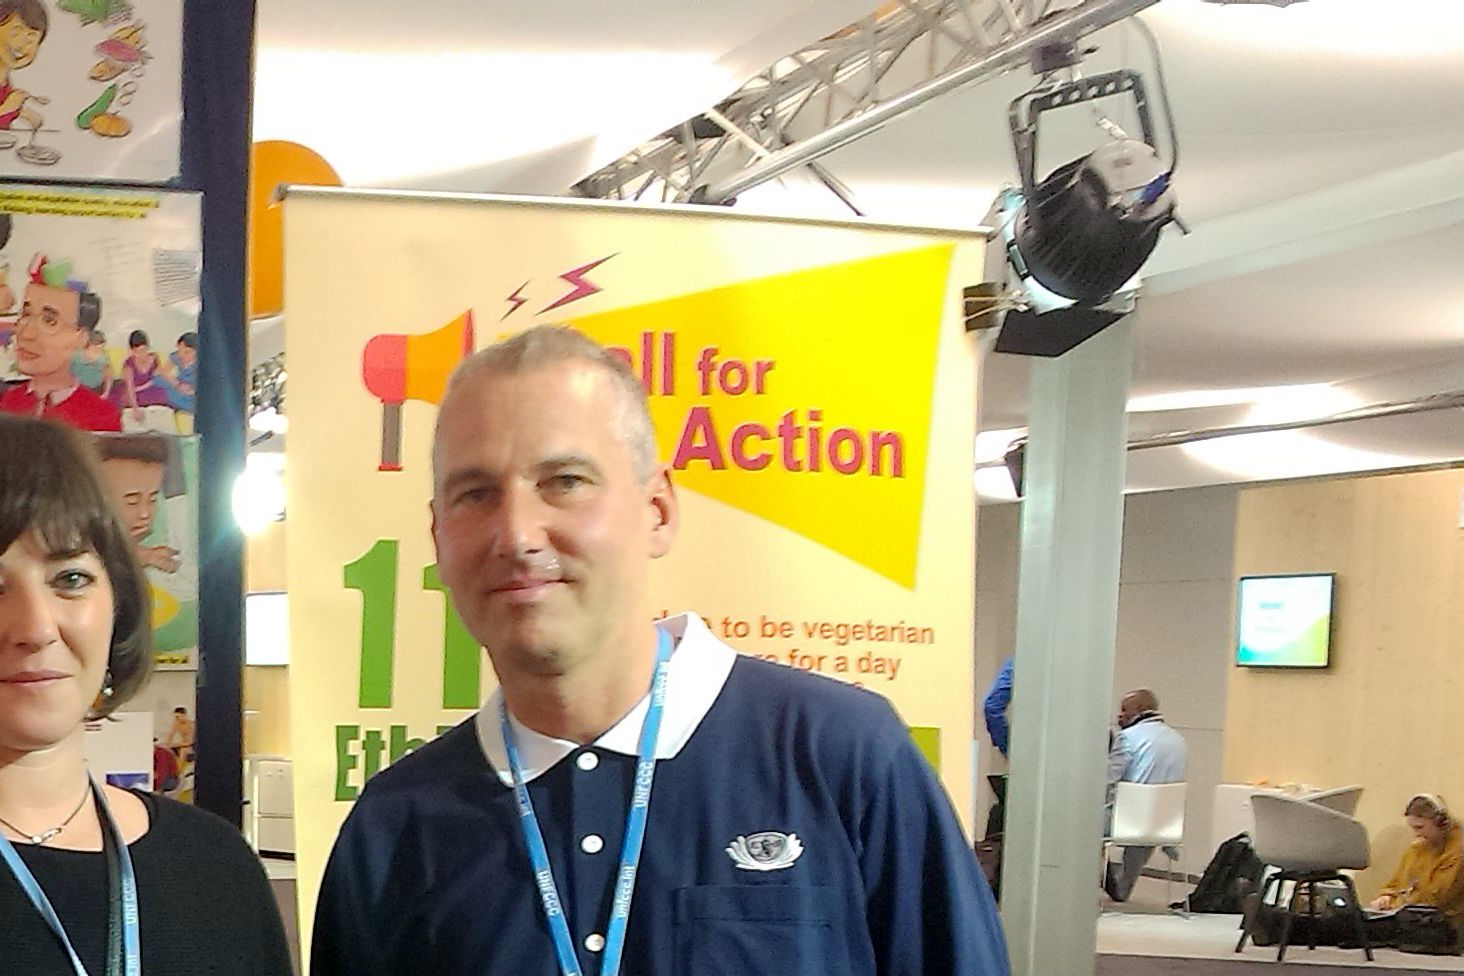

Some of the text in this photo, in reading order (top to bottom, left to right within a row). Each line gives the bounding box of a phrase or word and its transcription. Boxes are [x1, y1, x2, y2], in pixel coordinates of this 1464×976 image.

[697, 347, 775, 396] for
[672, 406, 904, 478] Action
[721, 616, 750, 639] to
[761, 615, 795, 638] be
[803, 619, 936, 646] vegetarian
[788, 648, 826, 672] for
[836, 654, 849, 674] a
[858, 650, 902, 681] day
